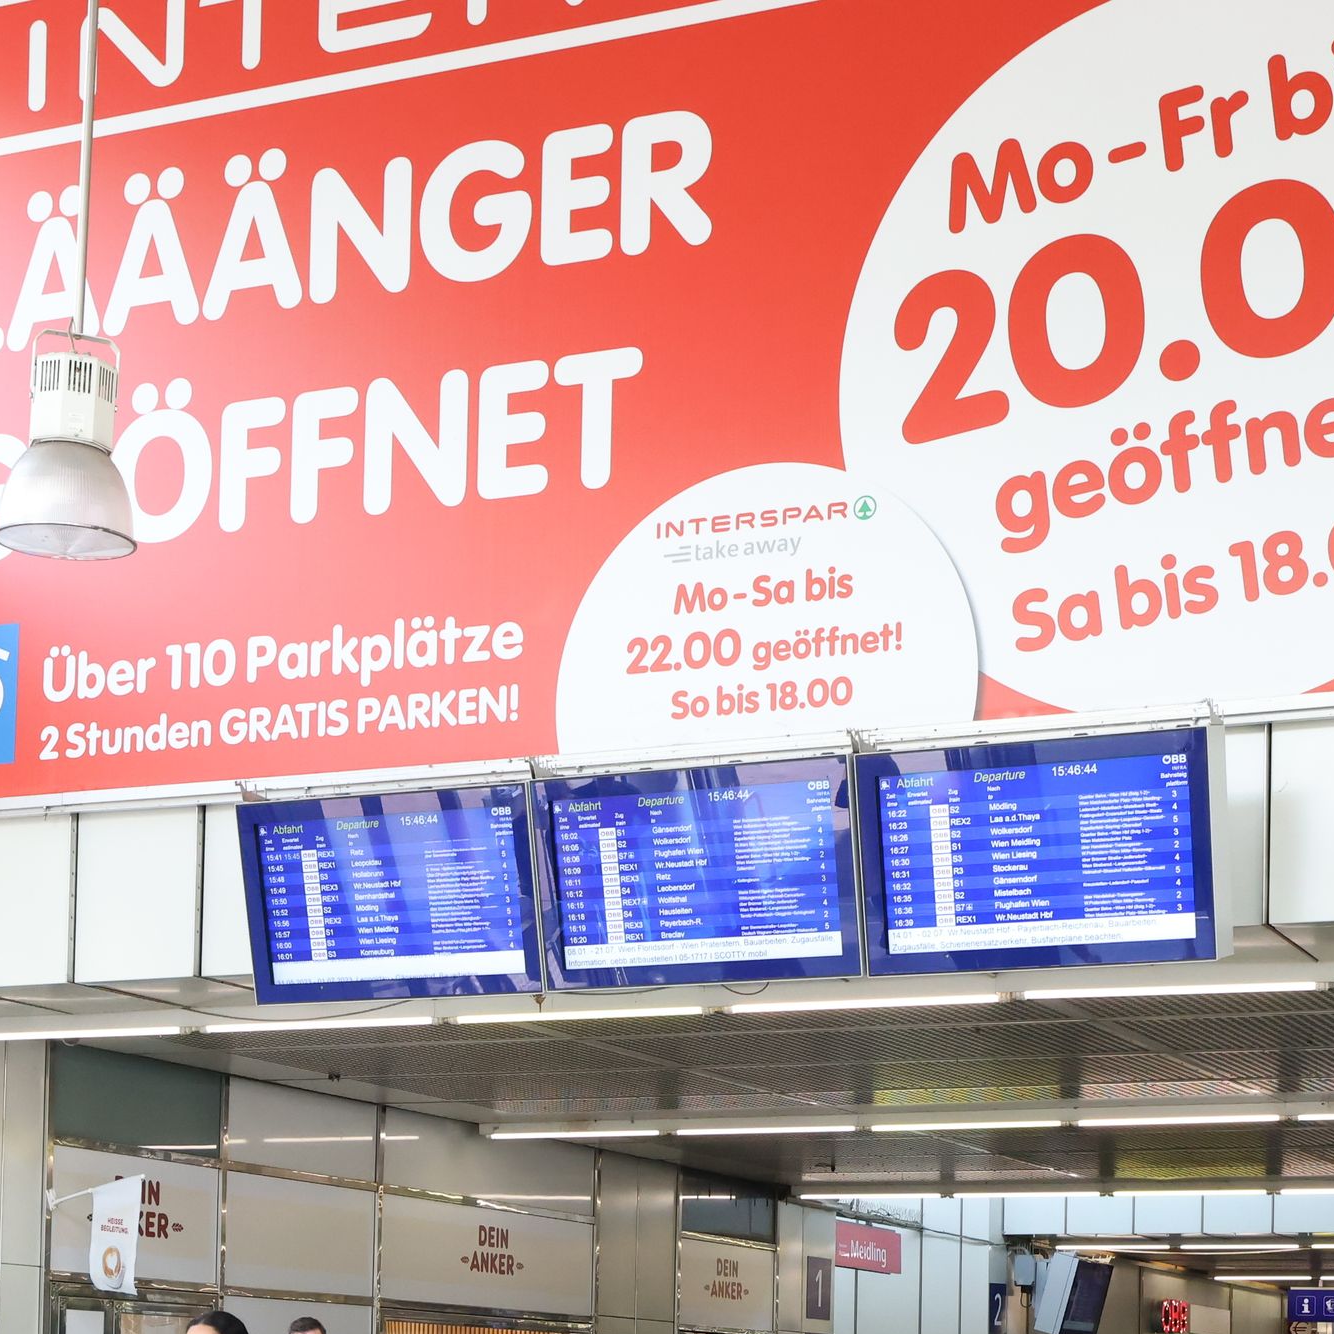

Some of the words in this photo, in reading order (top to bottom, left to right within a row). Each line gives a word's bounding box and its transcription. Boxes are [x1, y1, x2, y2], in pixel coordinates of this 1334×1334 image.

[656, 501, 848, 540] INTERSPAR
[695, 541, 739, 561] take
[743, 536, 802, 556] away
[805, 566, 854, 602] bis
[1012, 587, 1102, 652] Sa
[1116, 553, 1219, 631] bis
[626, 628, 742, 675] 22.00
[752, 622, 903, 671] geöffnet!
[42, 645, 147, 703] Über
[166, 639, 237, 690] 110
[246, 615, 524, 687] Parkplätze
[671, 690, 710, 720] So
[717, 684, 760, 716] bis
[766, 676, 854, 711] 18.00
[40, 730, 59, 761] 2
[67, 713, 212, 759] Stunden
[220, 699, 350, 746] GRATIS
[357, 683, 520, 733] PARKEN!
[896, 777, 934, 789] Abfahrt
[973, 770, 1026, 784] Departure
[1051, 763, 1098, 777] 15:46:44
[1162, 754, 1187, 765] ÖBB
[568, 801, 602, 812] Abfahrt
[637, 796, 684, 808] Departure
[707, 790, 749, 802] 15:46:44
[887, 810, 907, 818] 16:22
[949, 806, 960, 814] S2
[989, 801, 1017, 811] Mödling
[272, 824, 303, 835] Abfahrt
[336, 820, 380, 832] Departure
[400, 814, 438, 826] 15:46:44
[652, 824, 692, 834] Gänserndorf
[888, 822, 908, 830] 16:23
[950, 818, 971, 826] REX2
[989, 815, 1004, 824] Laa
[1004, 812, 1041, 823] a.d.Thaya
[653, 836, 692, 846] Wolkersdorf
[951, 831, 961, 839] S2
[990, 826, 1033, 836] Wolkersdorf
[654, 849, 686, 859] Flughafen
[687, 847, 704, 855] Wien
[890, 847, 909, 855] 16:27
[951, 843, 961, 851] S1
[991, 840, 1010, 848] Wien
[1011, 838, 1041, 848] Meidling
[619, 864, 638, 872] REX1
[695, 858, 708, 867] Hbf
[890, 858, 910, 866] 16:30
[952, 855, 963, 863] S3
[992, 852, 1010, 861] Wien
[1011, 851, 1037, 860] Liesing
[891, 871, 910, 879] 16:31
[953, 867, 964, 875] R3
[992, 864, 1029, 873] Stockerau
[892, 883, 912, 891] 16:32
[954, 879, 964, 888] S1
[993, 875, 1038, 885] Gänserndorf
[893, 895, 913, 903] 16:35
[954, 891, 965, 900] S2
[993, 888, 1032, 897] Mistelbach
[955, 904, 966, 912] S7
[994, 901, 1030, 910] Flughafen
[1031, 899, 1050, 907] Wien
[995, 912, 1039, 922] Wr.Neustadt
[1040, 911, 1054, 920] Hbf
[374, 925, 399, 934] Meidling
[625, 933, 644, 941] REX1
[479, 1224, 509, 1249] DEIN
[470, 1250, 514, 1276] ANKER
[850, 1239, 887, 1268] Meidling
[716, 1257, 739, 1278] DEIN
[710, 1280, 743, 1300] ANKER
[993, 1292, 1002, 1326] 2
